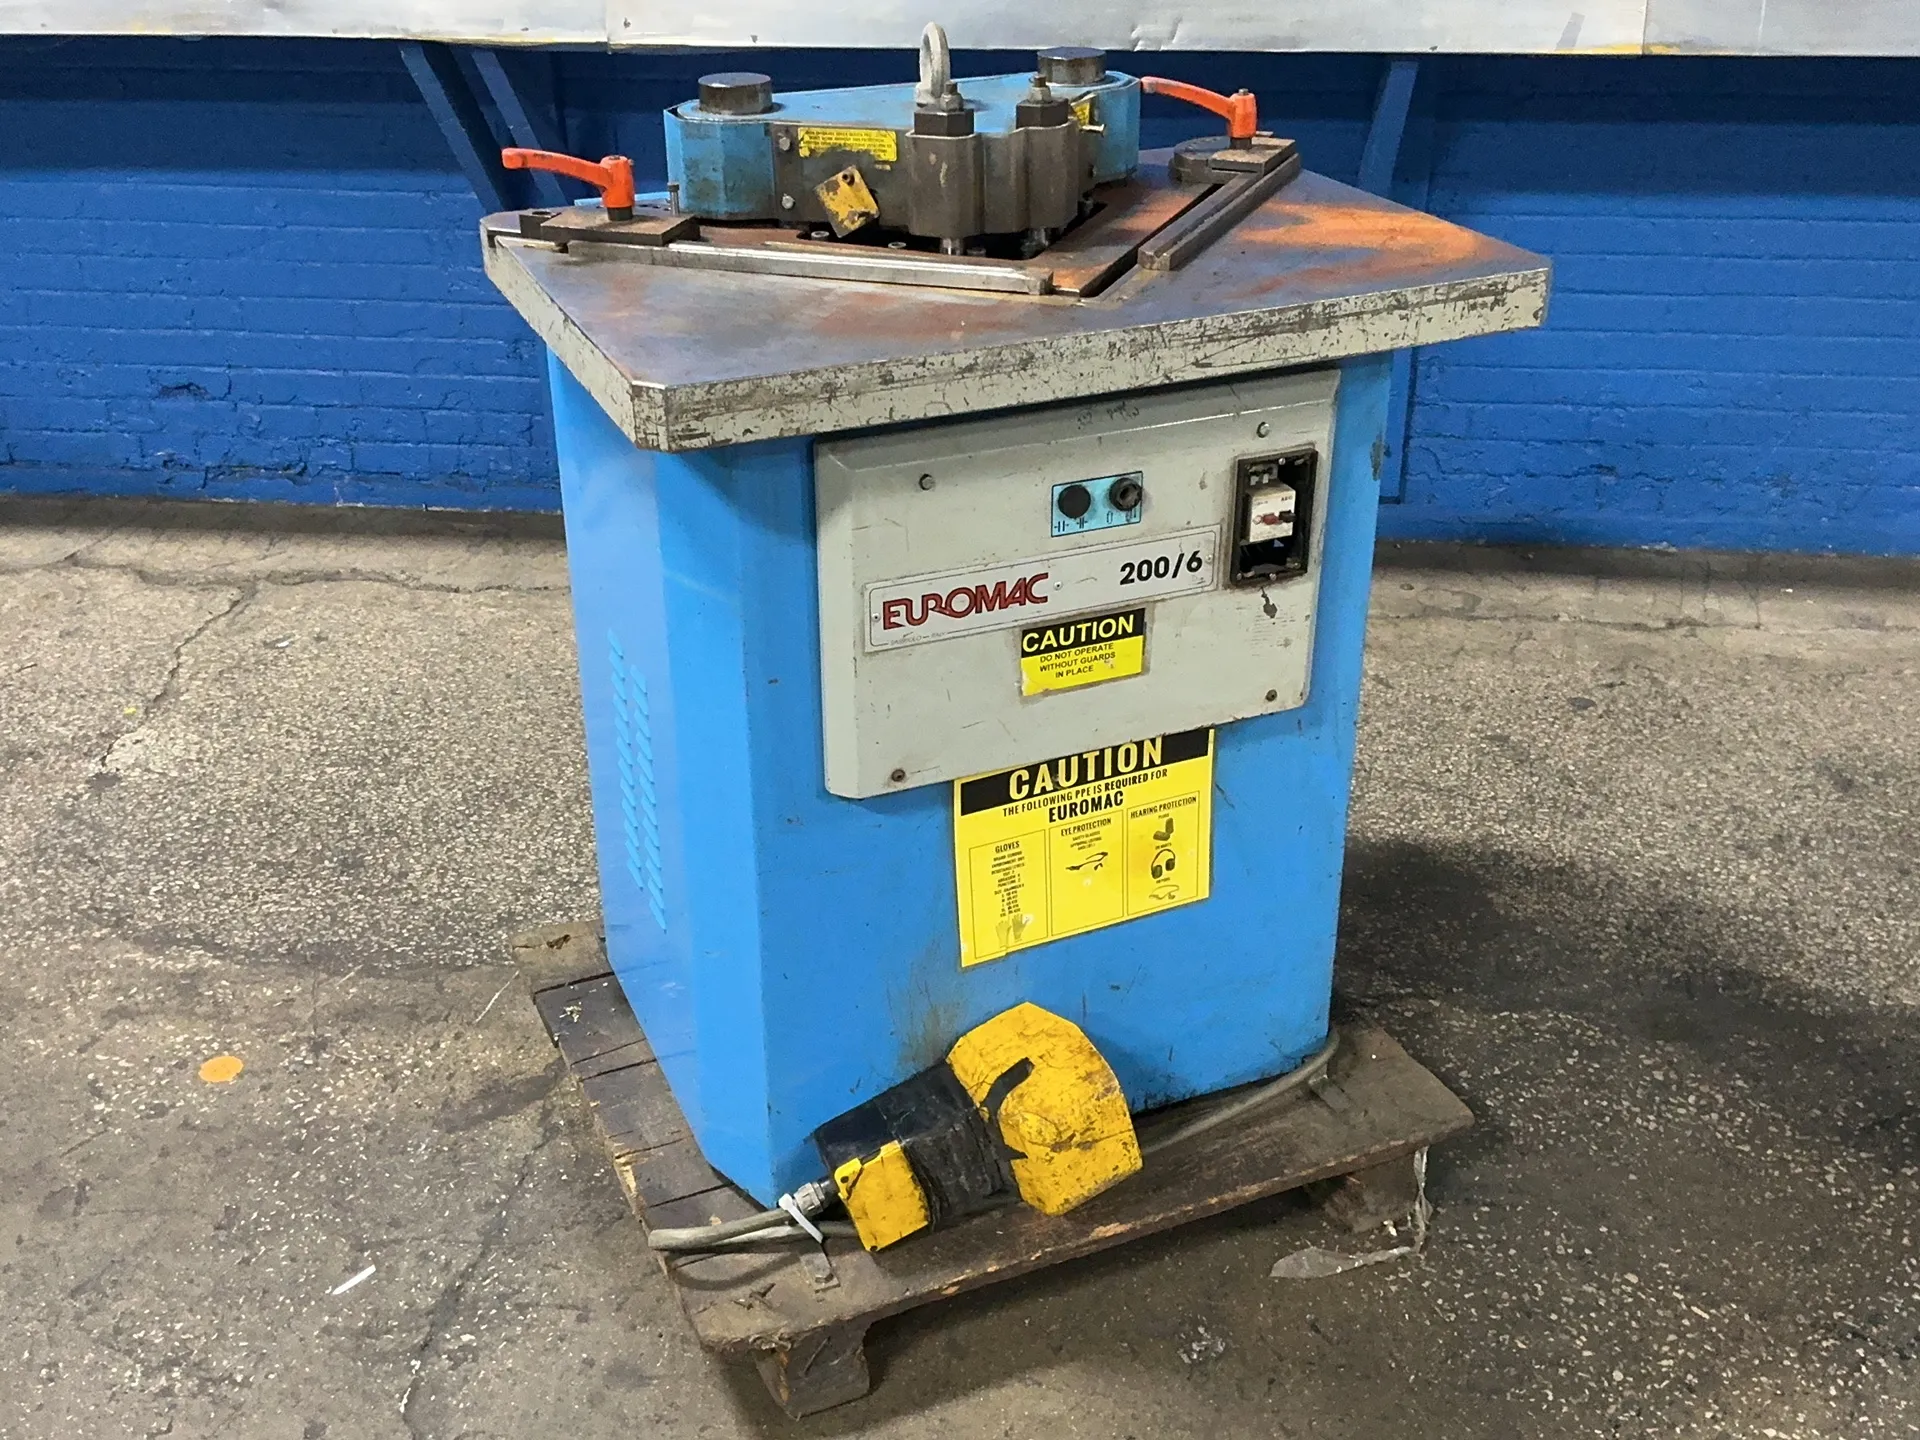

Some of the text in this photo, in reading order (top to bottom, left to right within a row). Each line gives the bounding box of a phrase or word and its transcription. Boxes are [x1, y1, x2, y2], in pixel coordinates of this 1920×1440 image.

[883, 550, 1203, 630] EUROMAC 200/6
[1022, 614, 1135, 652] CAUTION
[1039, 652, 1116, 672] WITHOUT GUARDS
[1040, 643, 1114, 664] DO NOT OPERATE
[1055, 664, 1094, 679] IN PLACE
[1008, 736, 1163, 801] CAUTION
[1003, 768, 1168, 817] THE FOLLOWING PPE IS REQUIRED FOR
[1049, 791, 1124, 824] EUROMAC
[1130, 796, 1197, 819] HEARING PROTECTION
[1061, 827, 1072, 836] EYE
[1072, 816, 1112, 834] PROTECTION
[995, 840, 1020, 854] GLOVES
